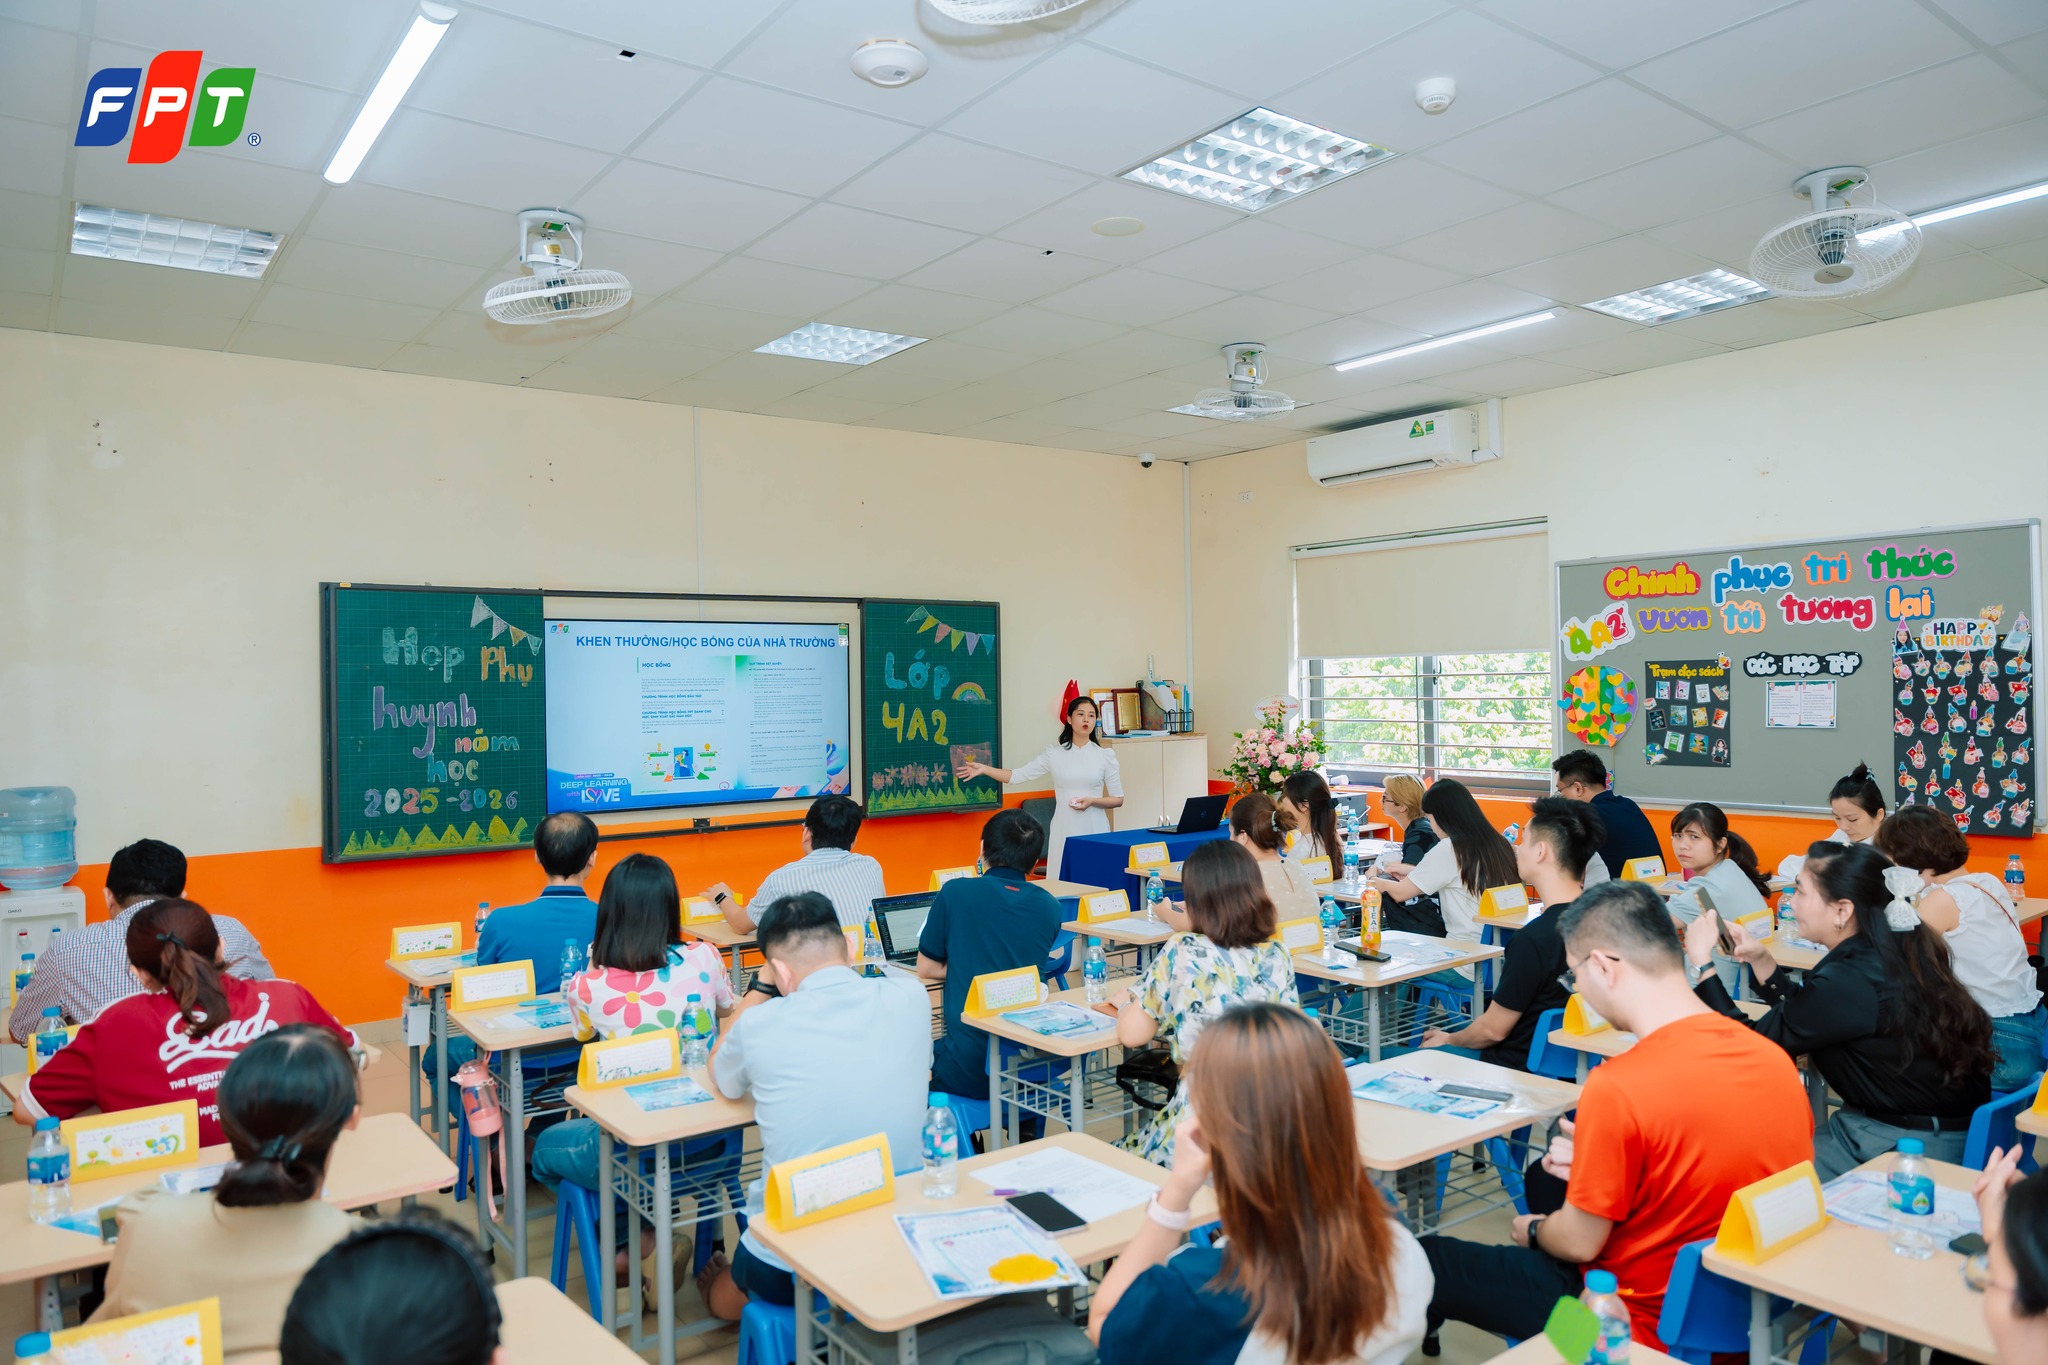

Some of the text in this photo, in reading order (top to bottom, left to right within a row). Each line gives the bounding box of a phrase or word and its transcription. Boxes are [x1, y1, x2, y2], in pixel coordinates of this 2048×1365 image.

[1606, 565, 1696, 597] Chinh
[1714, 557, 1791, 604] phục
[1866, 547, 1955, 580] thức
[1568, 608, 1627, 655] 4A2
[1722, 603, 1764, 632] tới
[1779, 594, 1874, 630] tương
[1888, 587, 1932, 618] lai
[1933, 621, 1989, 635] HAPPY
[576, 636, 611, 647] KHEN
[737, 635, 761, 648] CỦA
[763, 635, 787, 648] NHÀ
[789, 636, 836, 648] TRƯỜNG
[1925, 634, 1991, 647] BIRTHDAY
[381, 626, 465, 683] Họp
[1746, 652, 1860, 677] GÓC HỌC TẬP
[884, 649, 950, 700] Lớp
[1649, 663, 1725, 680] Trạm đọc sách
[372, 686, 477, 759] huynh
[882, 701, 949, 746] 4A2
[455, 728, 520, 754] năm
[427, 752, 479, 786] học
[560, 778, 628, 789] DEEP LEARNING
[169, 1070, 226, 1090] THE ESSENTI
[197, 1080, 220, 1092] ADVA
